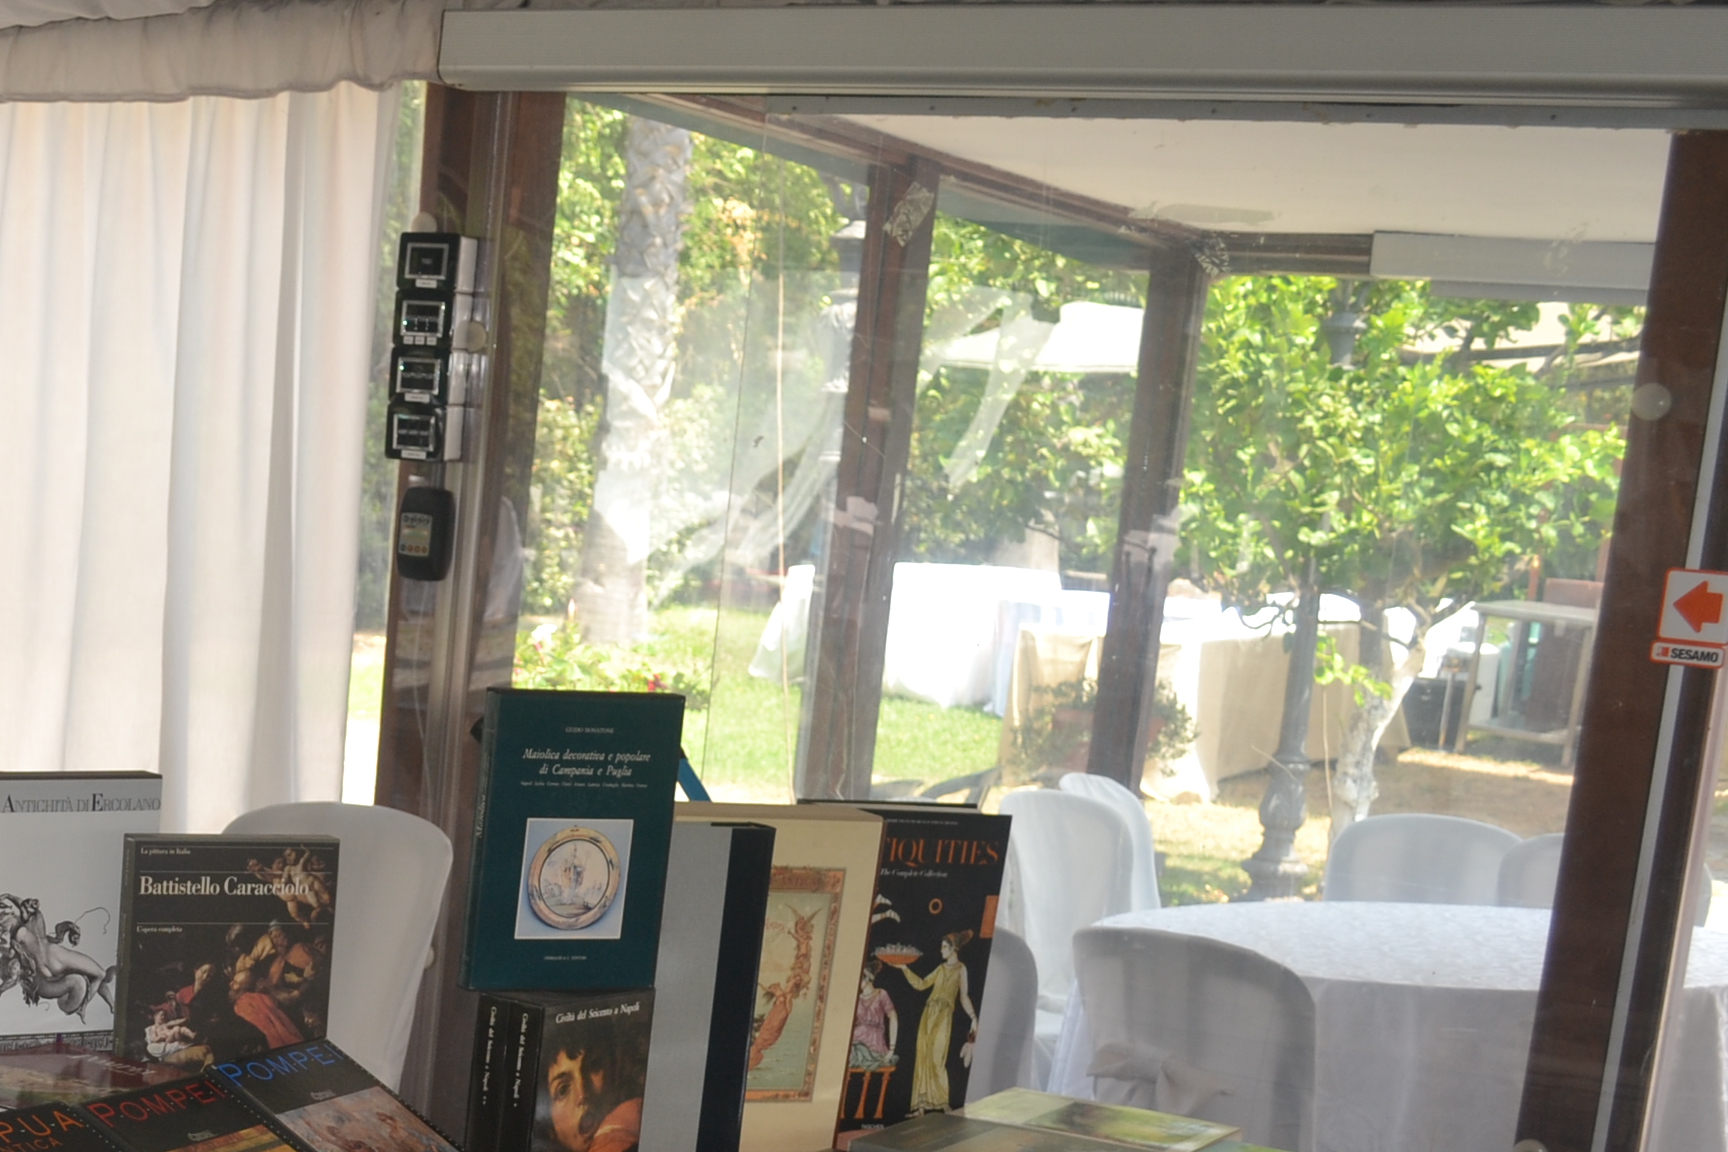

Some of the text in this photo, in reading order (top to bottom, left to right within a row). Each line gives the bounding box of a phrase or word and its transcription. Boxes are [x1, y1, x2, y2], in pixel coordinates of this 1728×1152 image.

[1670, 647, 1719, 663] SESAMO
[522, 748, 651, 764] Maiolica decorativa e popolare
[539, 763, 632, 779] di Campania e Puglia
[77, 798, 89, 813] DI
[91, 792, 161, 812] ERCOLANO
[140, 847, 148, 855] La
[149, 847, 169, 856] pittura
[176, 847, 191, 855] Italia
[880, 868, 949, 879] The Complete Collection
[138, 875, 309, 897] Battistello Caracciolo
[136, 925, 183, 934] L'opera completa
[555, 1001, 641, 1025] Civiltà del Seicento a Napoli
[218, 1042, 344, 1088] POMPEI
[482, 1071, 490, 1092] Napoli
[86, 1079, 226, 1128] POMPEI
